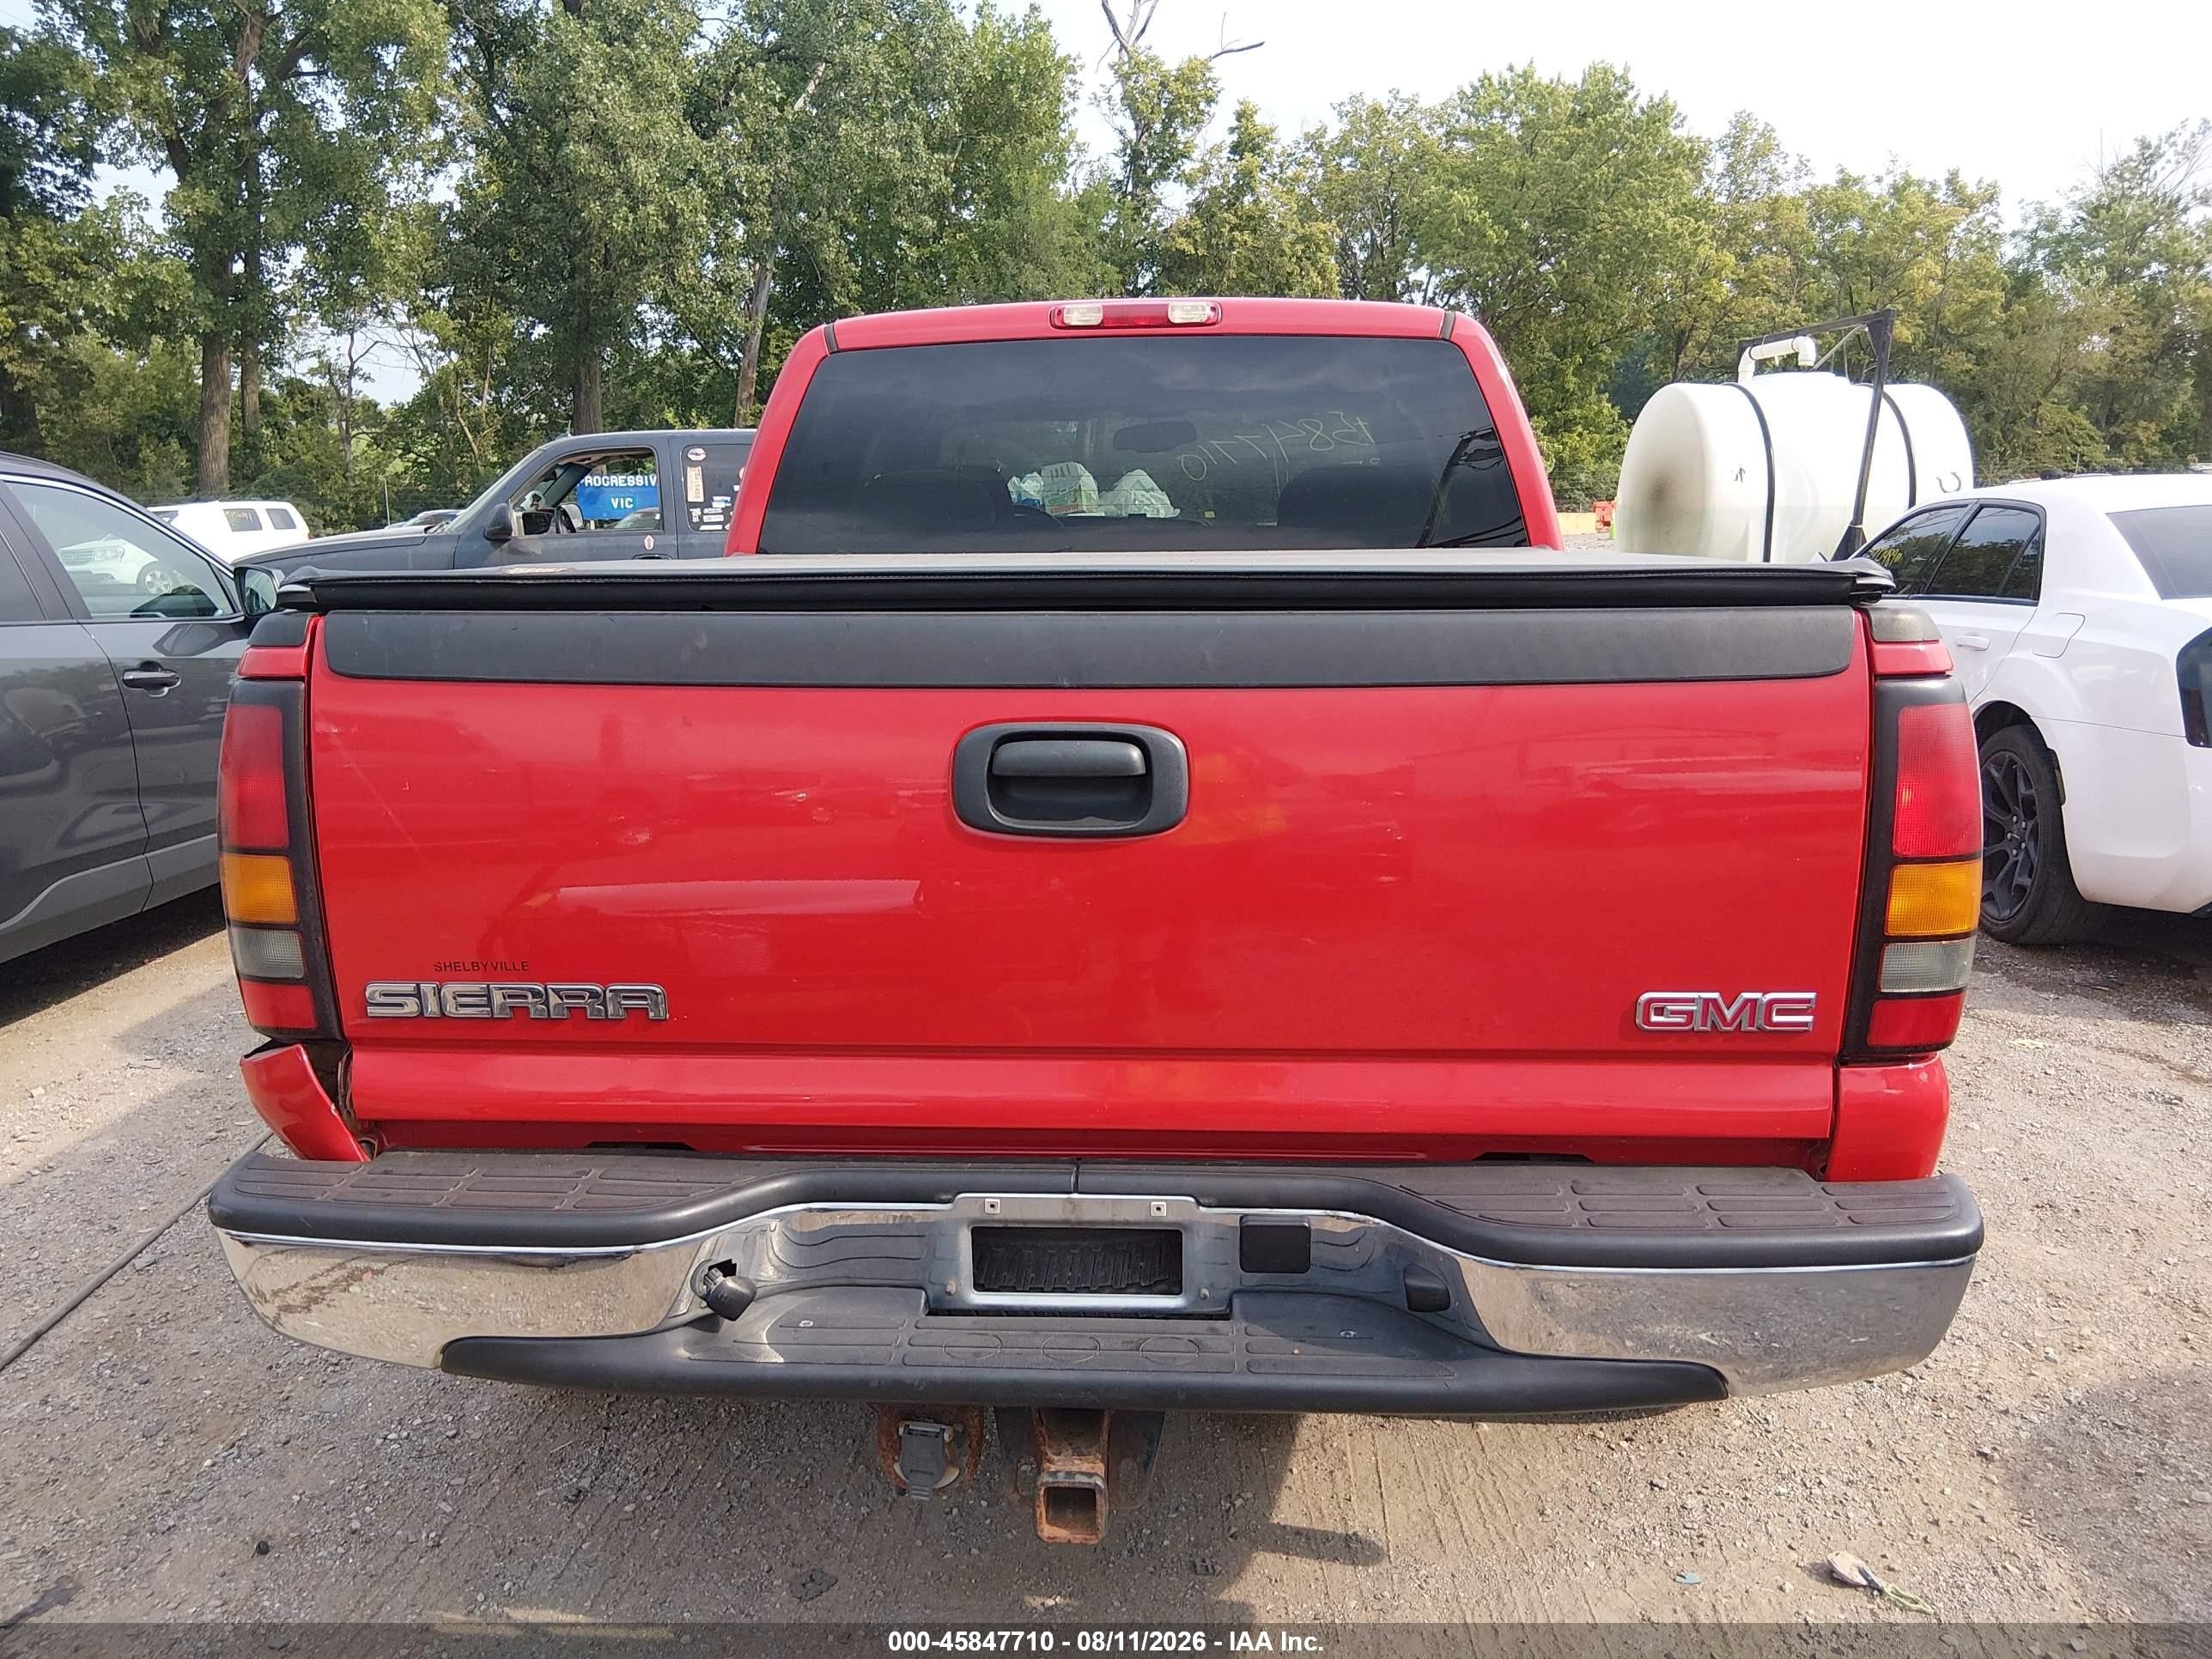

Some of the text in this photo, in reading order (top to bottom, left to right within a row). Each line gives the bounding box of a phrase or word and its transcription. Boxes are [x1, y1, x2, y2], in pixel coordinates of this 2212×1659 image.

[611, 497, 634, 509] VIC
[434, 961, 530, 972] SHELBYVILLE
[365, 981, 667, 1020] SIERRA
[1636, 992, 1817, 1031] GMC
